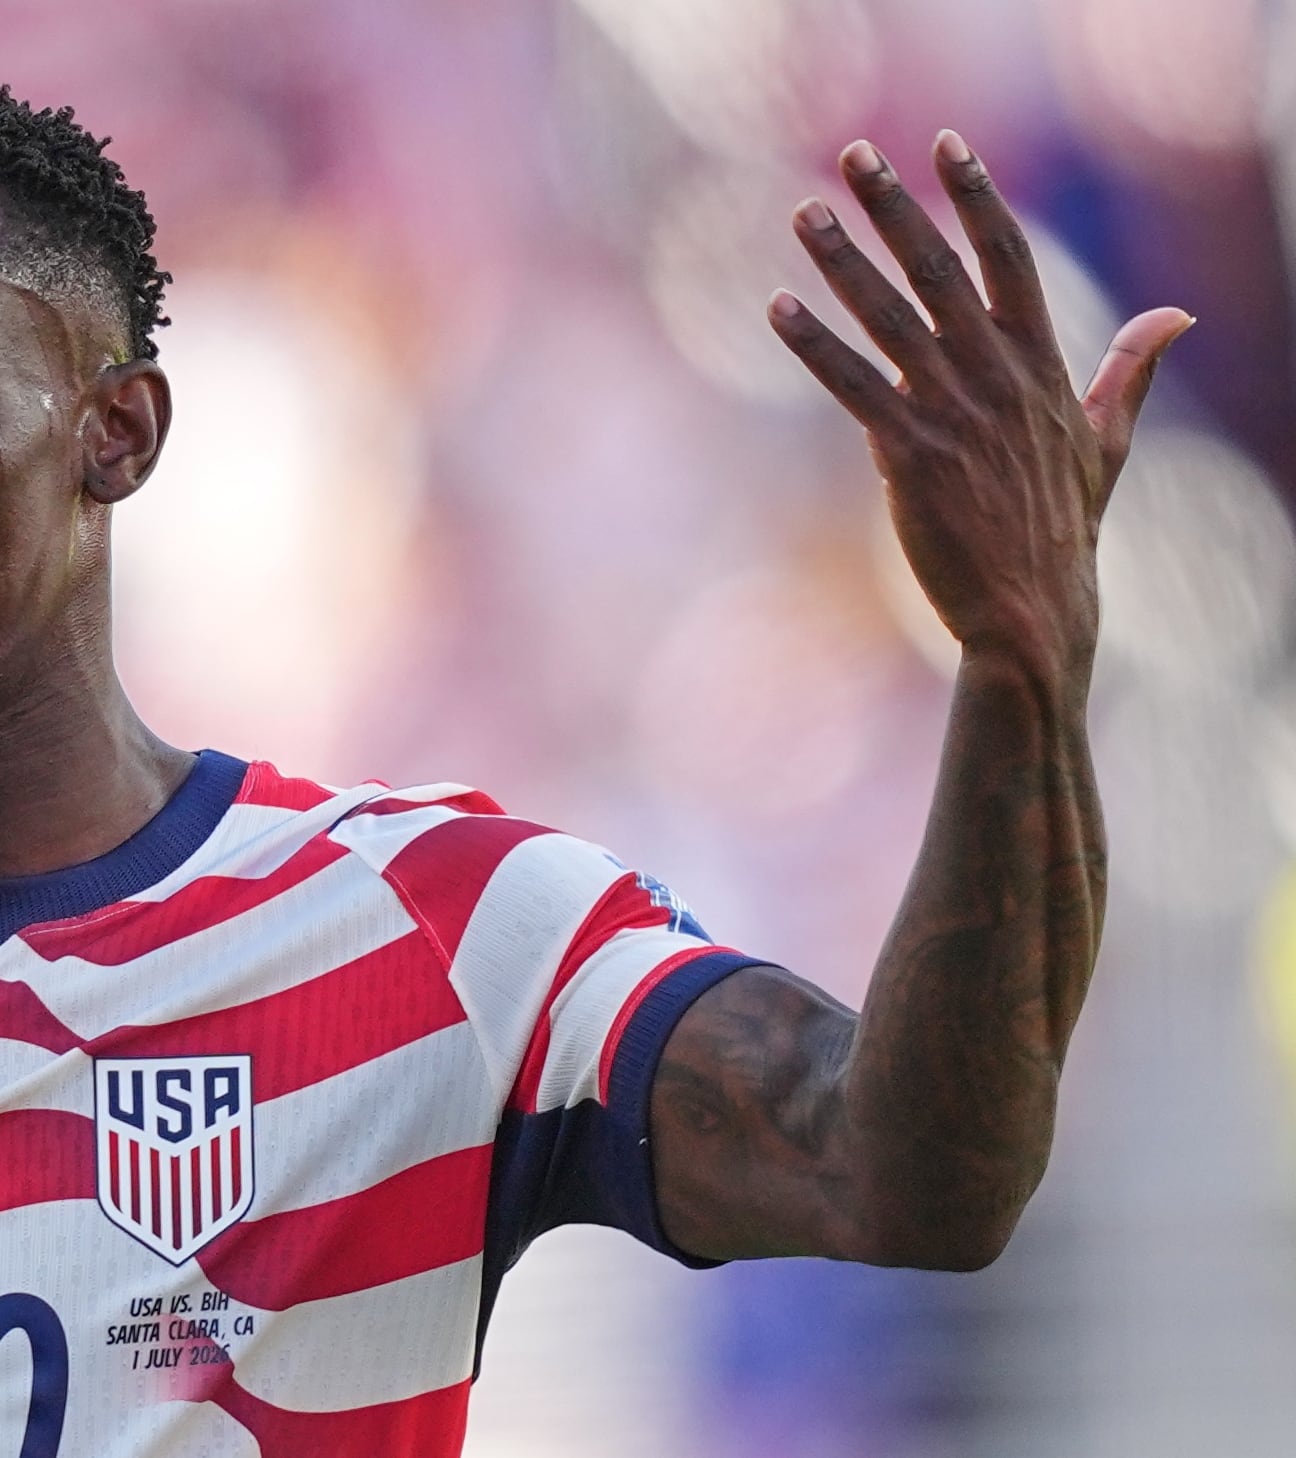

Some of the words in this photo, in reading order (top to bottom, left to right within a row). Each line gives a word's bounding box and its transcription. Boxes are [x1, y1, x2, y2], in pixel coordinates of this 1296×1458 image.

[108, 1067, 240, 1143] USA
[130, 1298, 162, 1317] USA
[169, 1294, 193, 1313] VS.
[200, 1292, 229, 1312] BIH
[106, 1323, 160, 1345] SANTA
[168, 1318, 226, 1340] CLARA,
[233, 1316, 254, 1335] CA
[132, 1351, 139, 1369] 1
[144, 1348, 183, 1369] JULY
